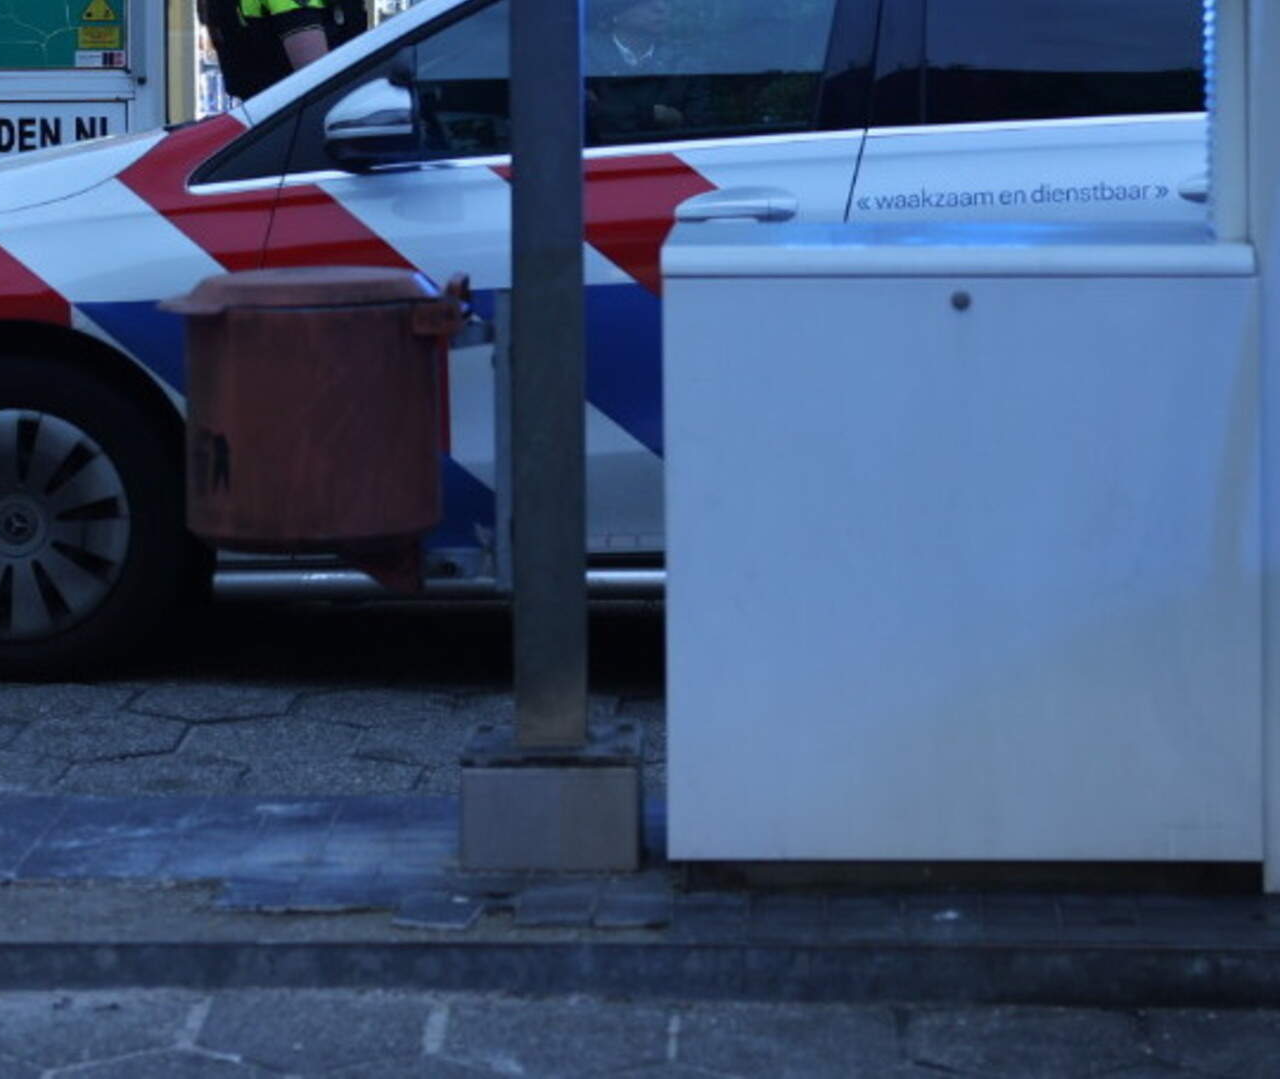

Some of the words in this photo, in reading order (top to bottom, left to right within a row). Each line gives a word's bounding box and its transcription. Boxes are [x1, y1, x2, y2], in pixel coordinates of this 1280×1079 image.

[875, 188, 994, 211] waakzaam
[998, 188, 1026, 206] en
[1030, 182, 1151, 205] dienstbaar
